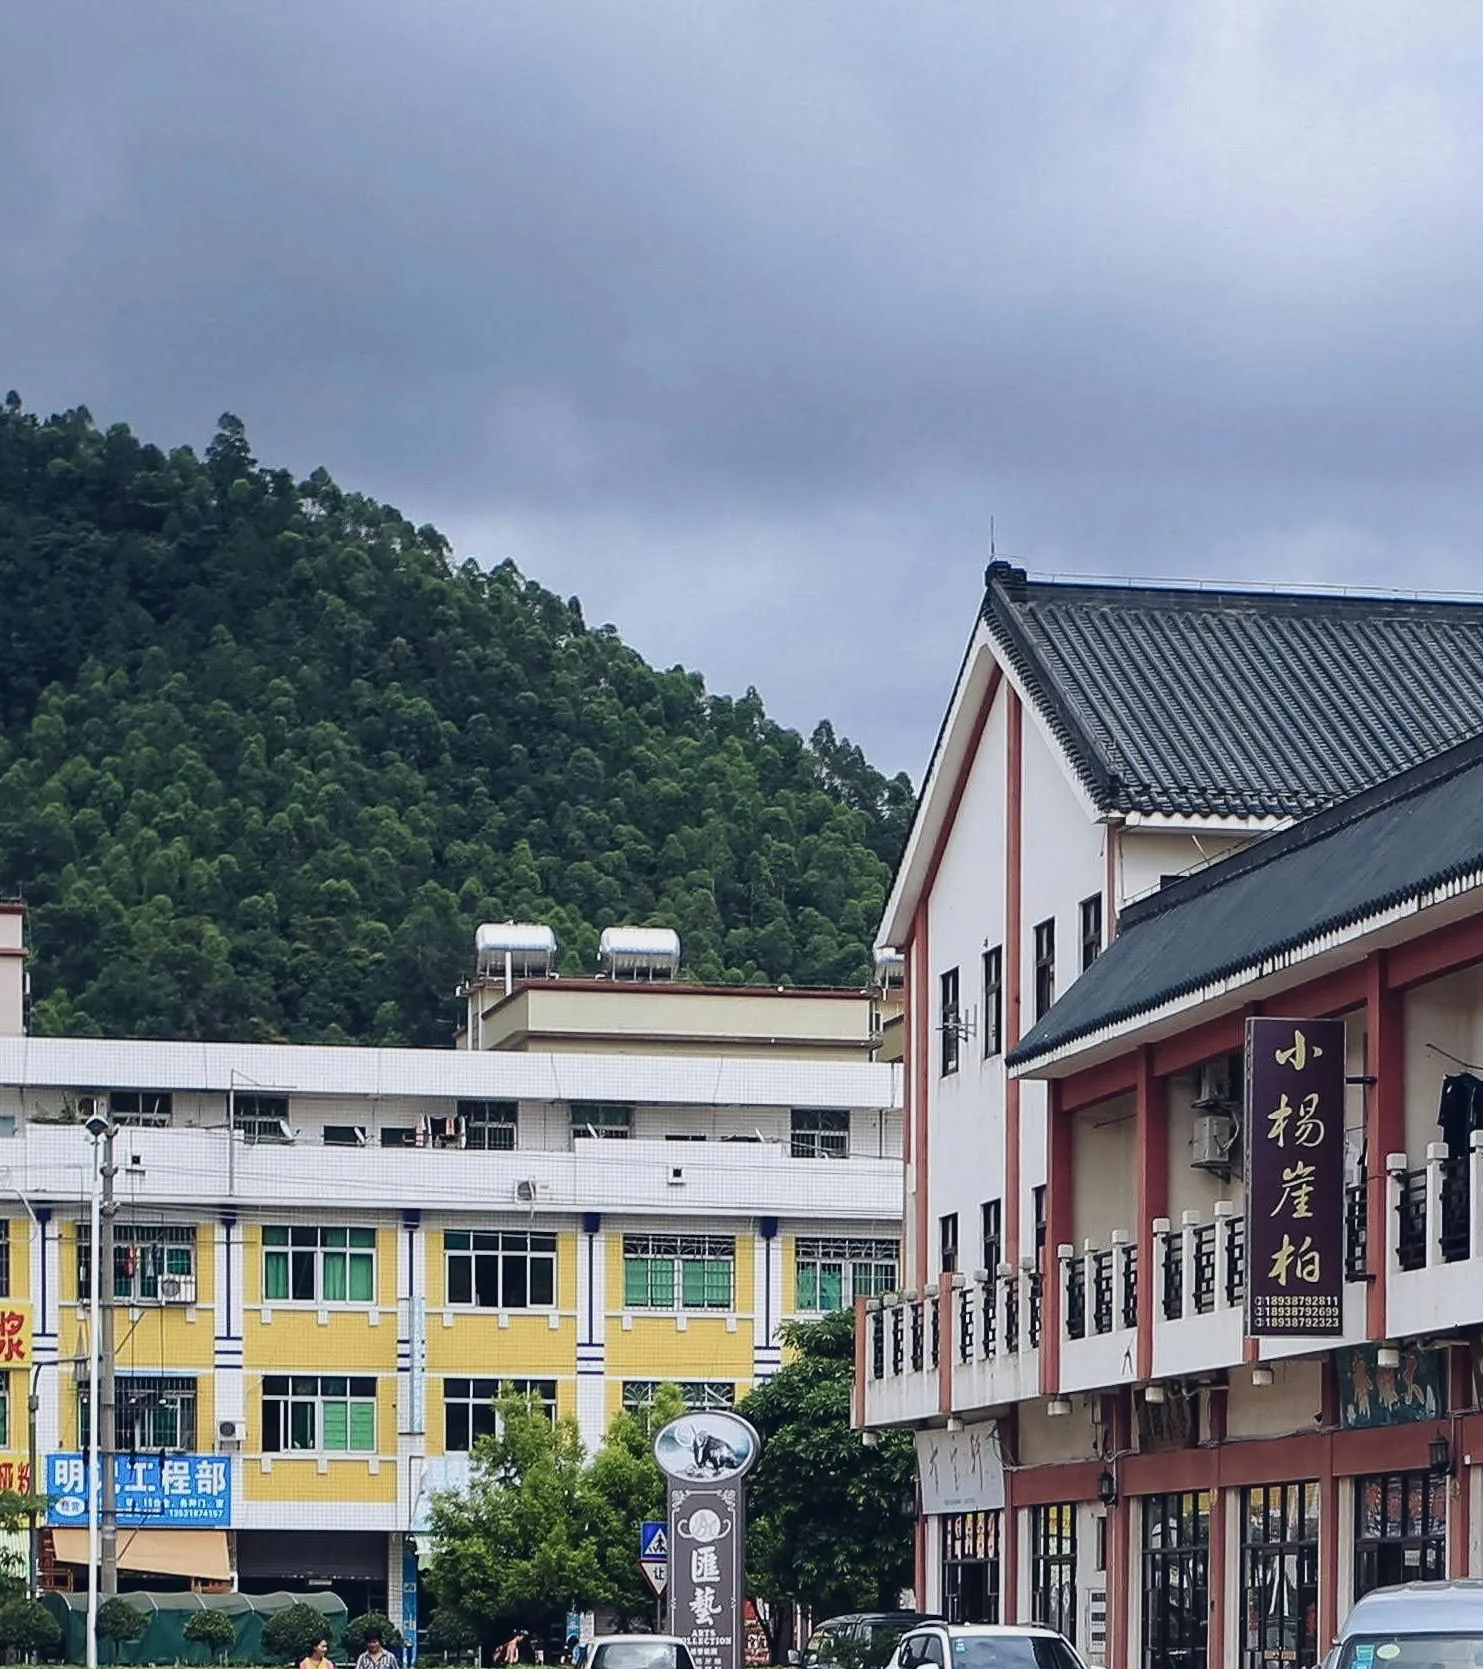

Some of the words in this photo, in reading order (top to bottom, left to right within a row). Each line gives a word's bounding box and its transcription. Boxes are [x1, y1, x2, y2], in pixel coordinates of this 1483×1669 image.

[1264, 1296, 1338, 1306] 18938792811
[1264, 1307, 1339, 1316] 18938792699
[1264, 1317, 1339, 1327] 18938792323
[54, 1458, 227, 1496] 明工程部
[684, 1636, 732, 1646] LLECTION
